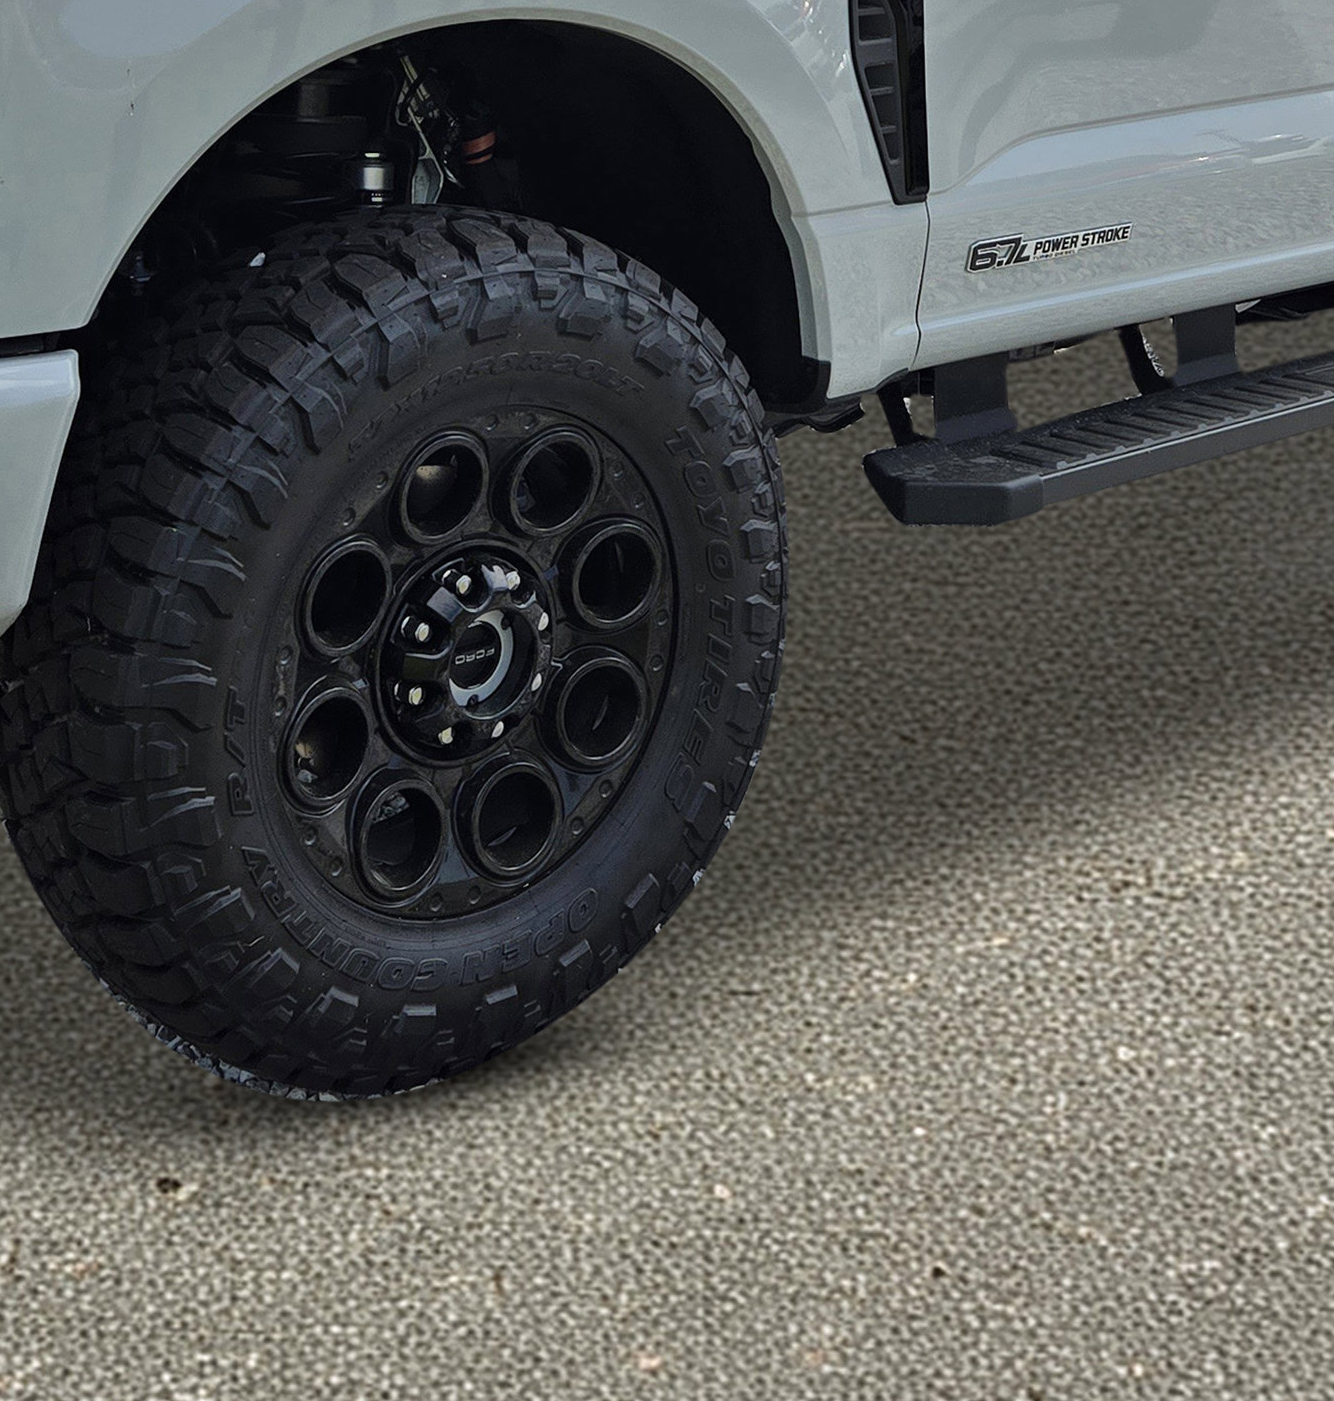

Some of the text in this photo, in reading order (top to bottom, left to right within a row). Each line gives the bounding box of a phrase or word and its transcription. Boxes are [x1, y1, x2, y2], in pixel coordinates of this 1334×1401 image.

[969, 225, 1131, 271] 6.7L POWER STROKE
[663, 425, 737, 813] TOYO TIRES
[223, 684, 599, 994] OPEN COUNTRY R/T
